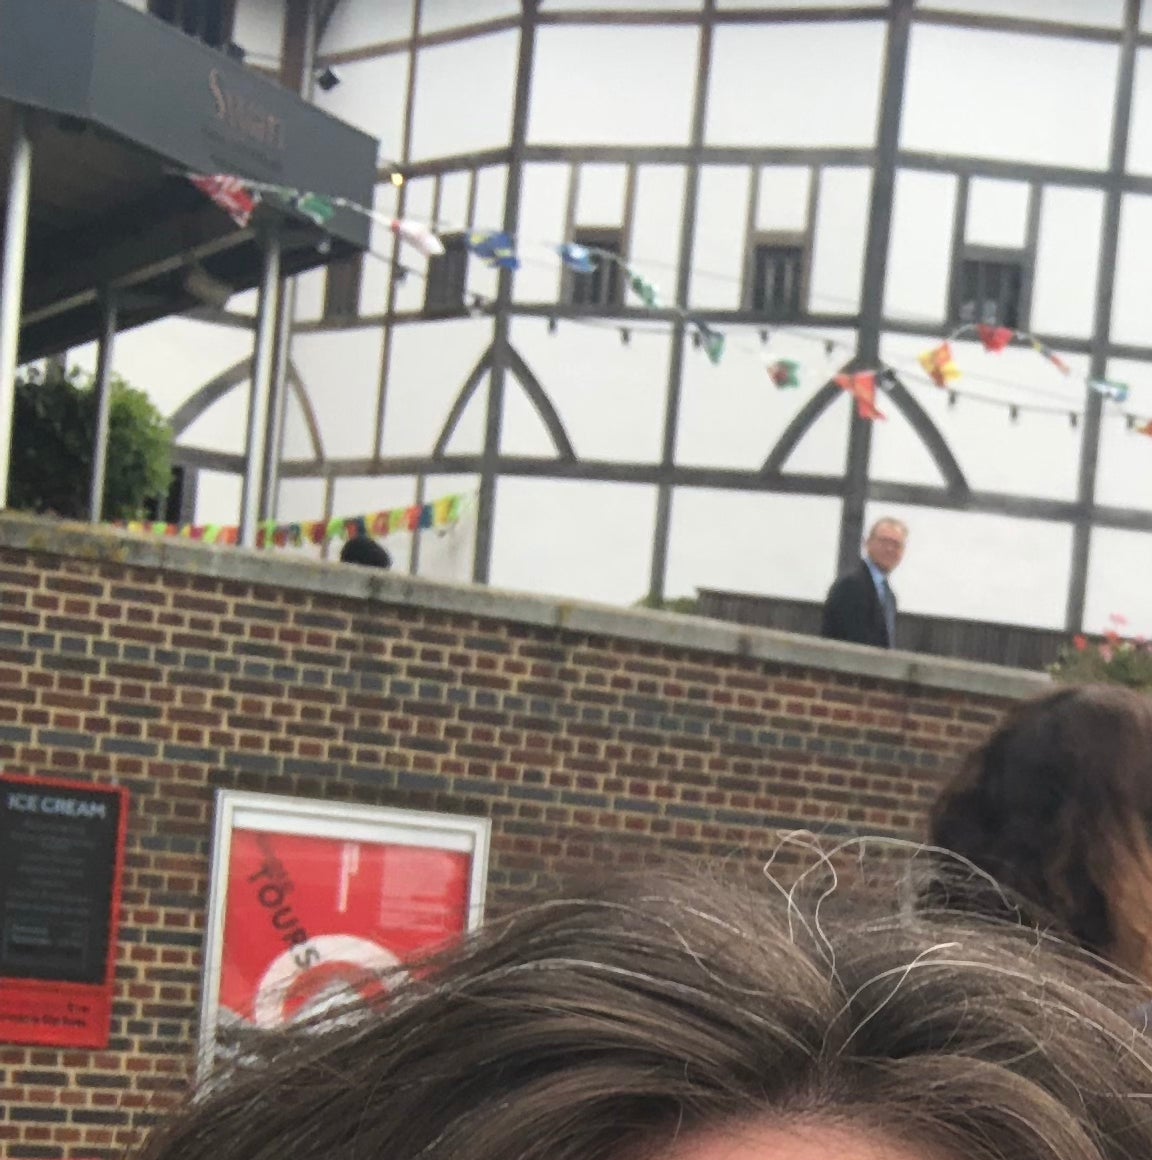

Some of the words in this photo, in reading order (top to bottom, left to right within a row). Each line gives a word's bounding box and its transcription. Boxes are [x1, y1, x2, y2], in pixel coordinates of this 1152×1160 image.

[6, 793, 37, 813] ICE
[41, 798, 107, 820] CREAM
[248, 860, 320, 969] TOURS
